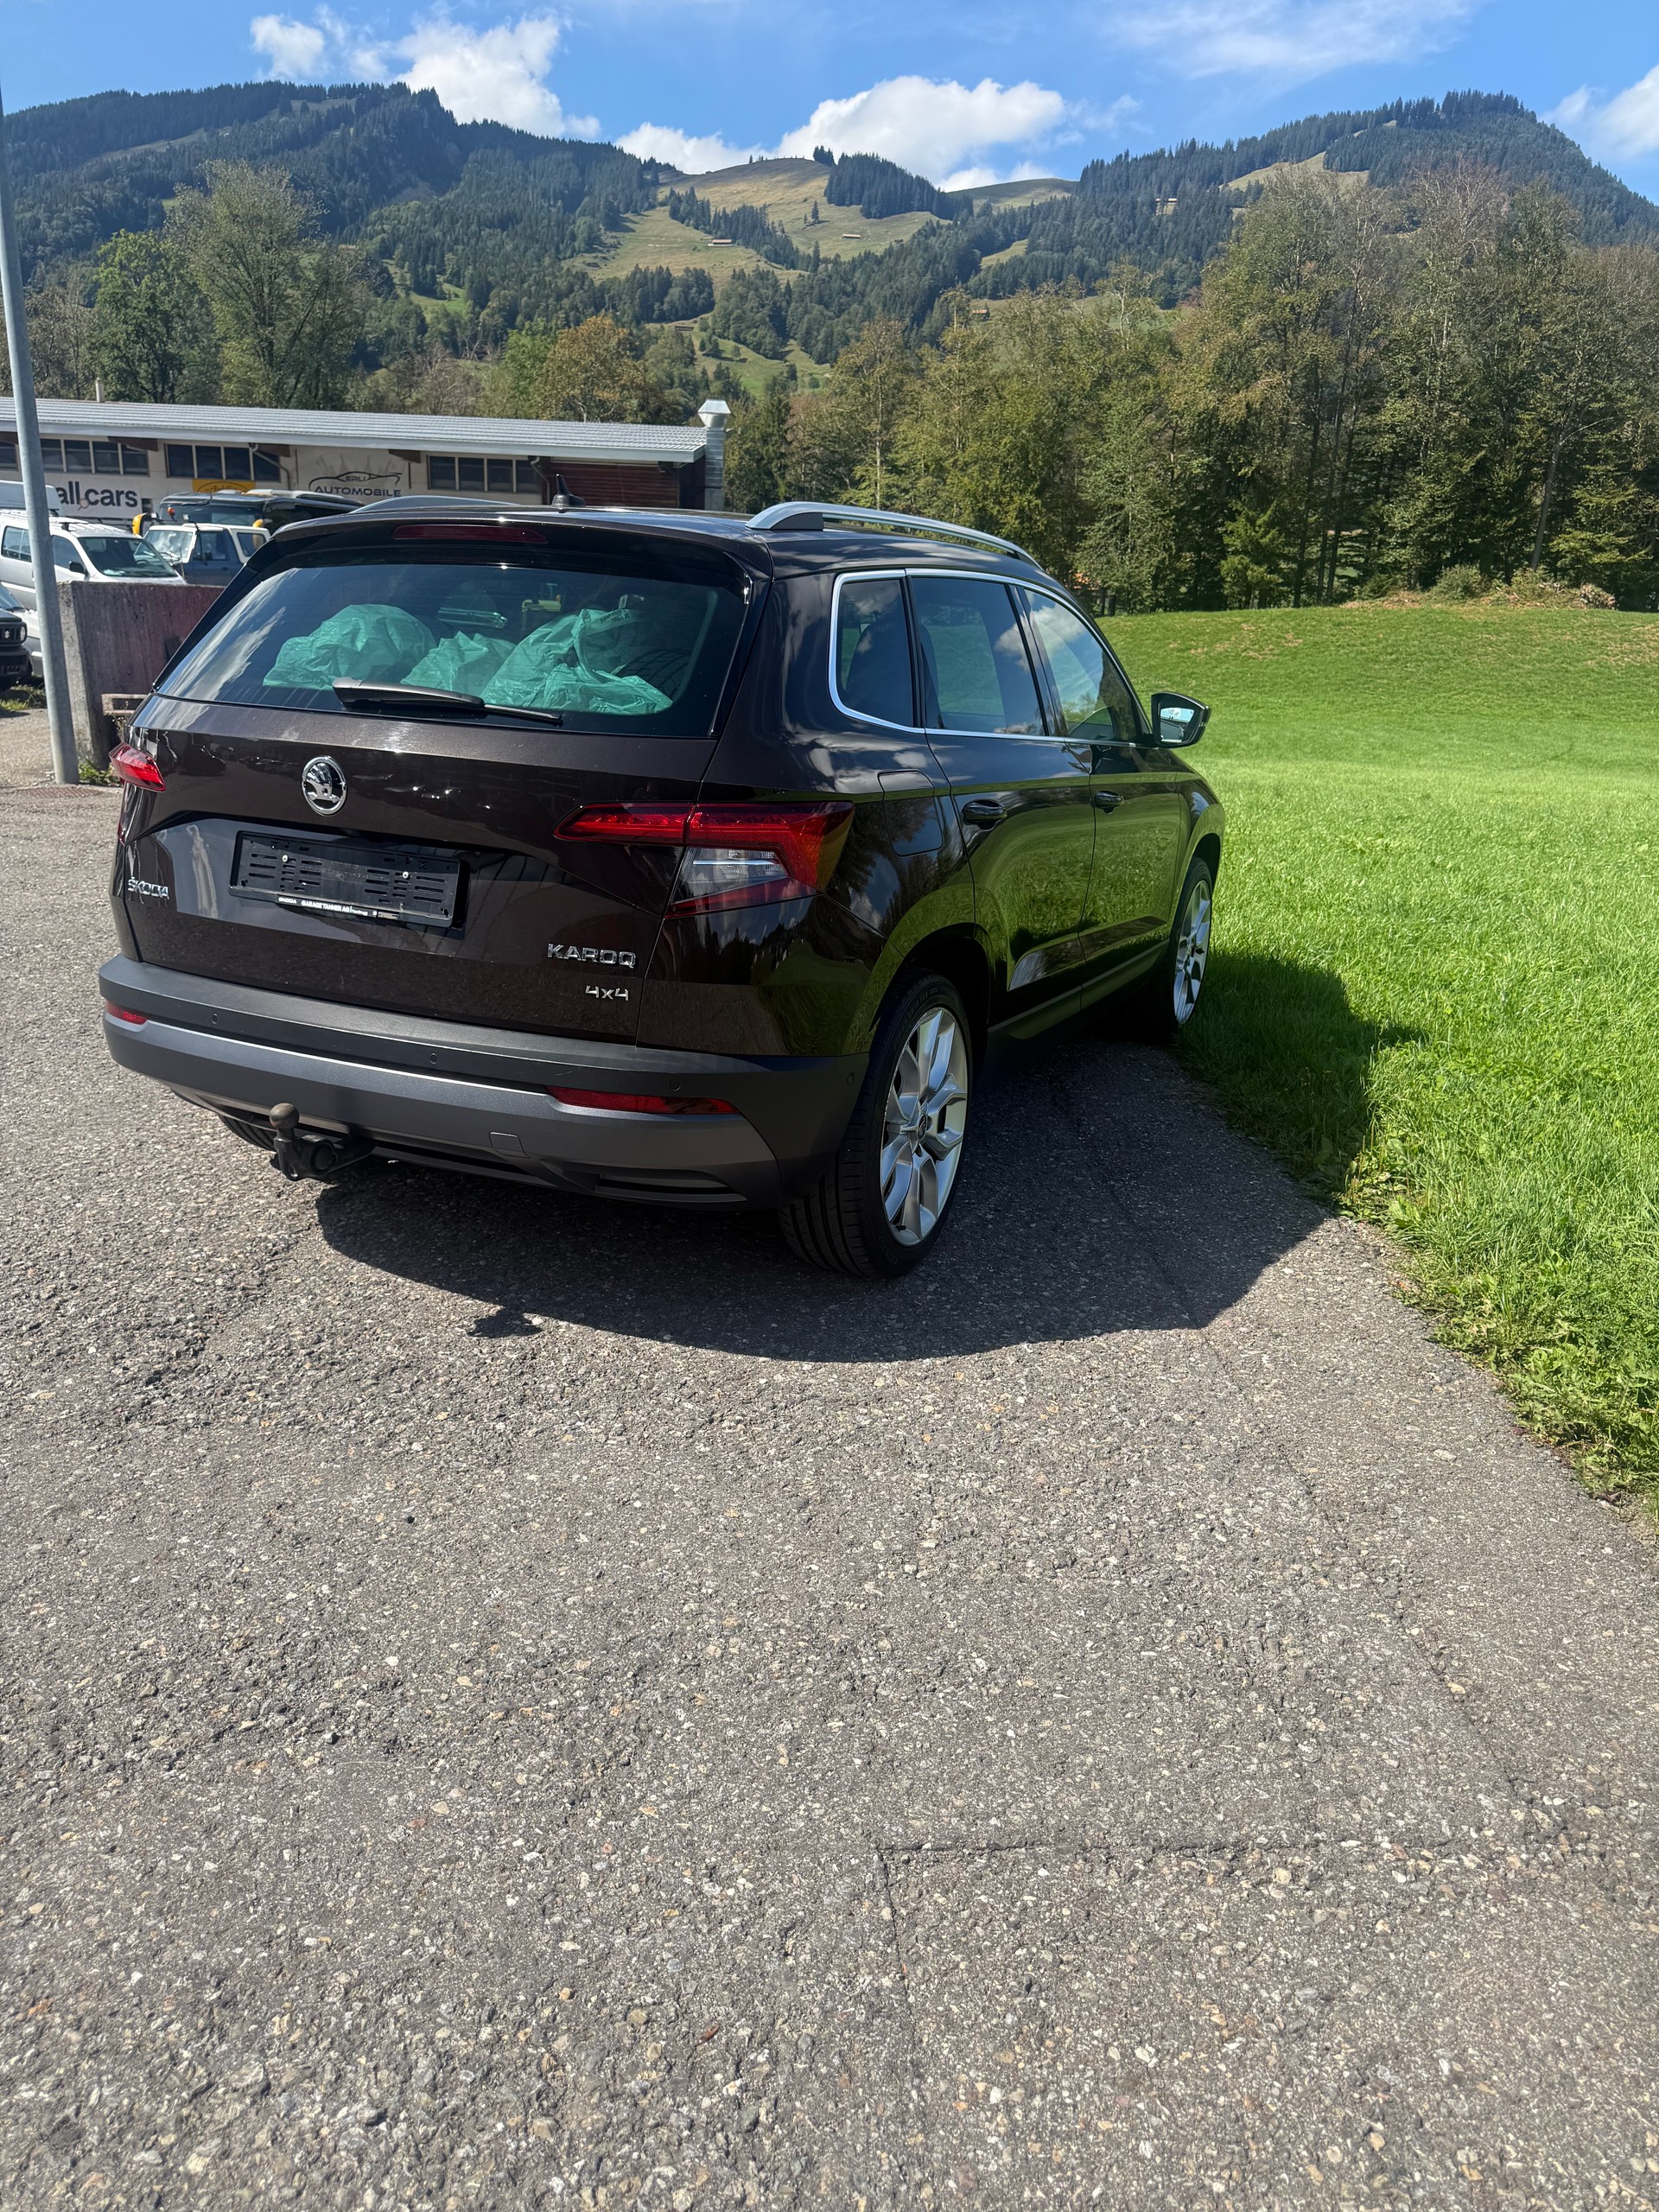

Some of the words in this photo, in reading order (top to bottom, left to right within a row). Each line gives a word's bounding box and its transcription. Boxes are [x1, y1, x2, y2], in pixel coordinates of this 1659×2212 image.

[56, 481, 80, 505] all
[85, 488, 138, 508] cars
[315, 486, 402, 497] AUTOMOBILE
[547, 943, 636, 969] KAROQ
[585, 985, 629, 1001] 4x4
